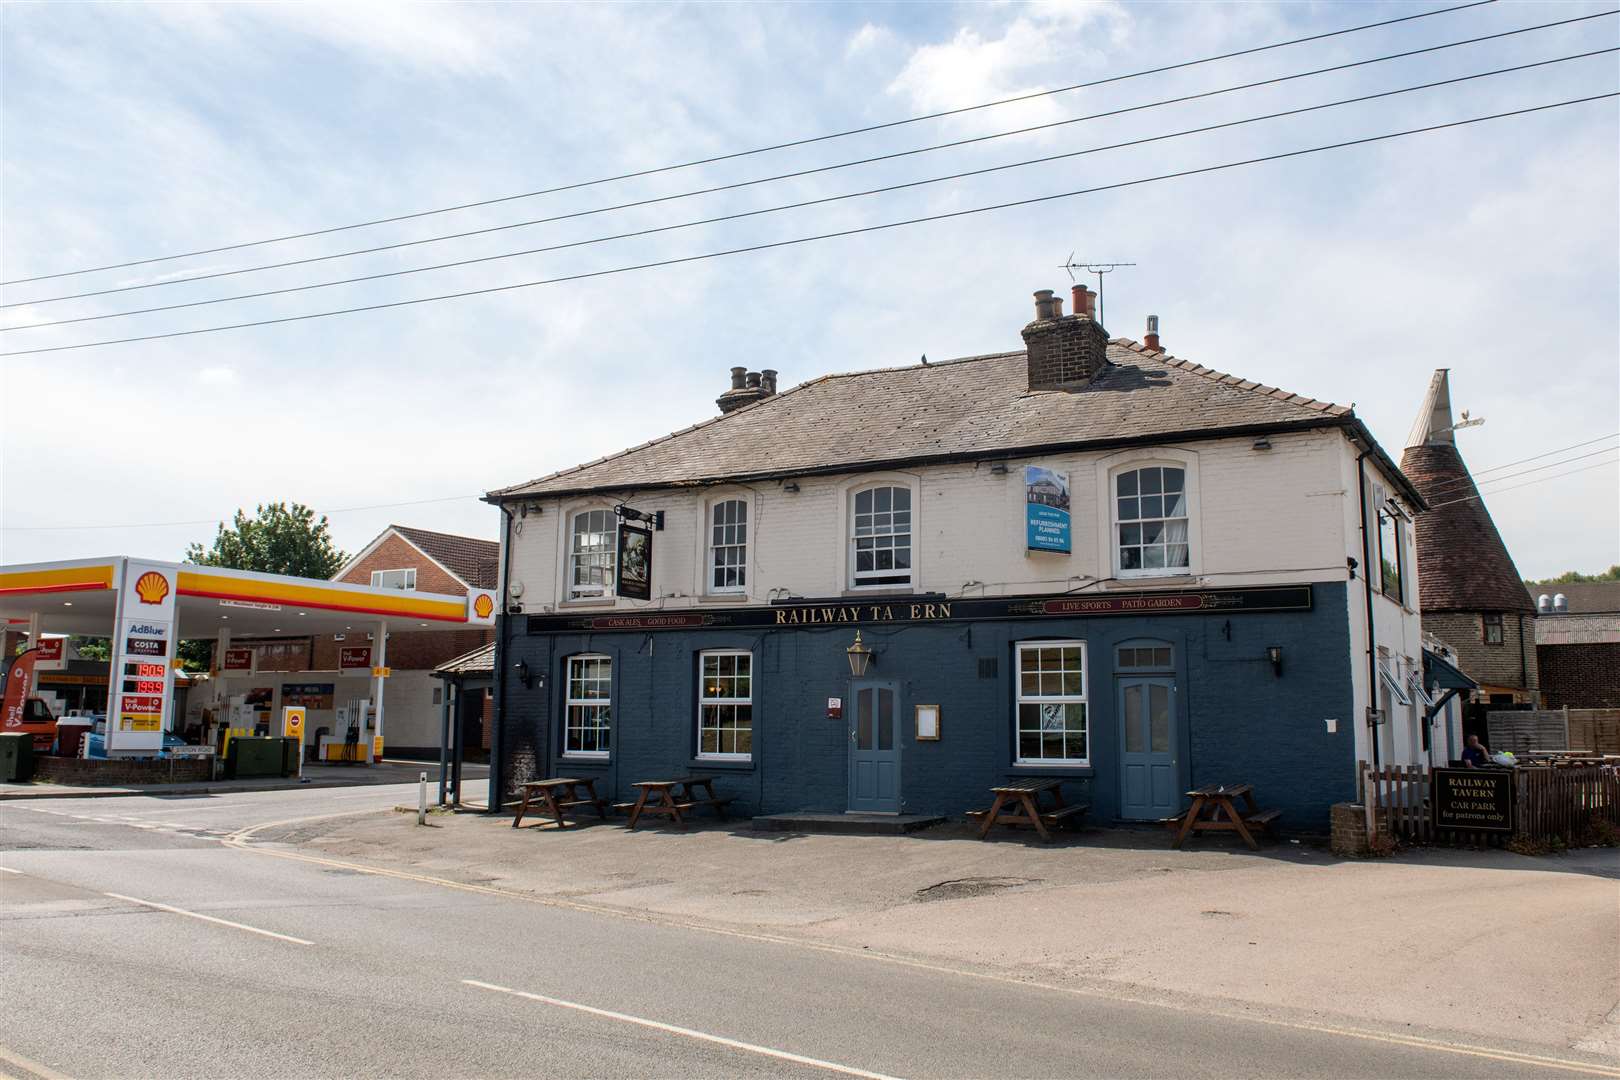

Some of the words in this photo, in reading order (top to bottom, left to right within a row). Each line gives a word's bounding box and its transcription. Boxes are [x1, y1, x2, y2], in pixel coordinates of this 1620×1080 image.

[1062, 601, 1080, 610] LIVE
[1081, 600, 1112, 610] SPORTS
[1121, 599, 1146, 609] PATIO
[1147, 598, 1182, 608] GARDEN
[776, 607, 860, 624] RAILWAY
[608, 617, 625, 626] CASK
[625, 617, 641, 626] ALES
[647, 616, 667, 625] GOOD
[667, 616, 686, 625] FOOD
[130, 624, 164, 636] AdBlue
[134, 641, 159, 649] COSTA
[125, 703, 157, 711] V-Power
[1448, 778, 1496, 788] RAILWAY
[1452, 789, 1494, 797] TAVERN
[1450, 801, 1469, 809] CAR
[1471, 802, 1496, 811] PARK
[1442, 809, 1454, 818] for
[1455, 812, 1485, 820] patrons
[1487, 812, 1504, 822] only
